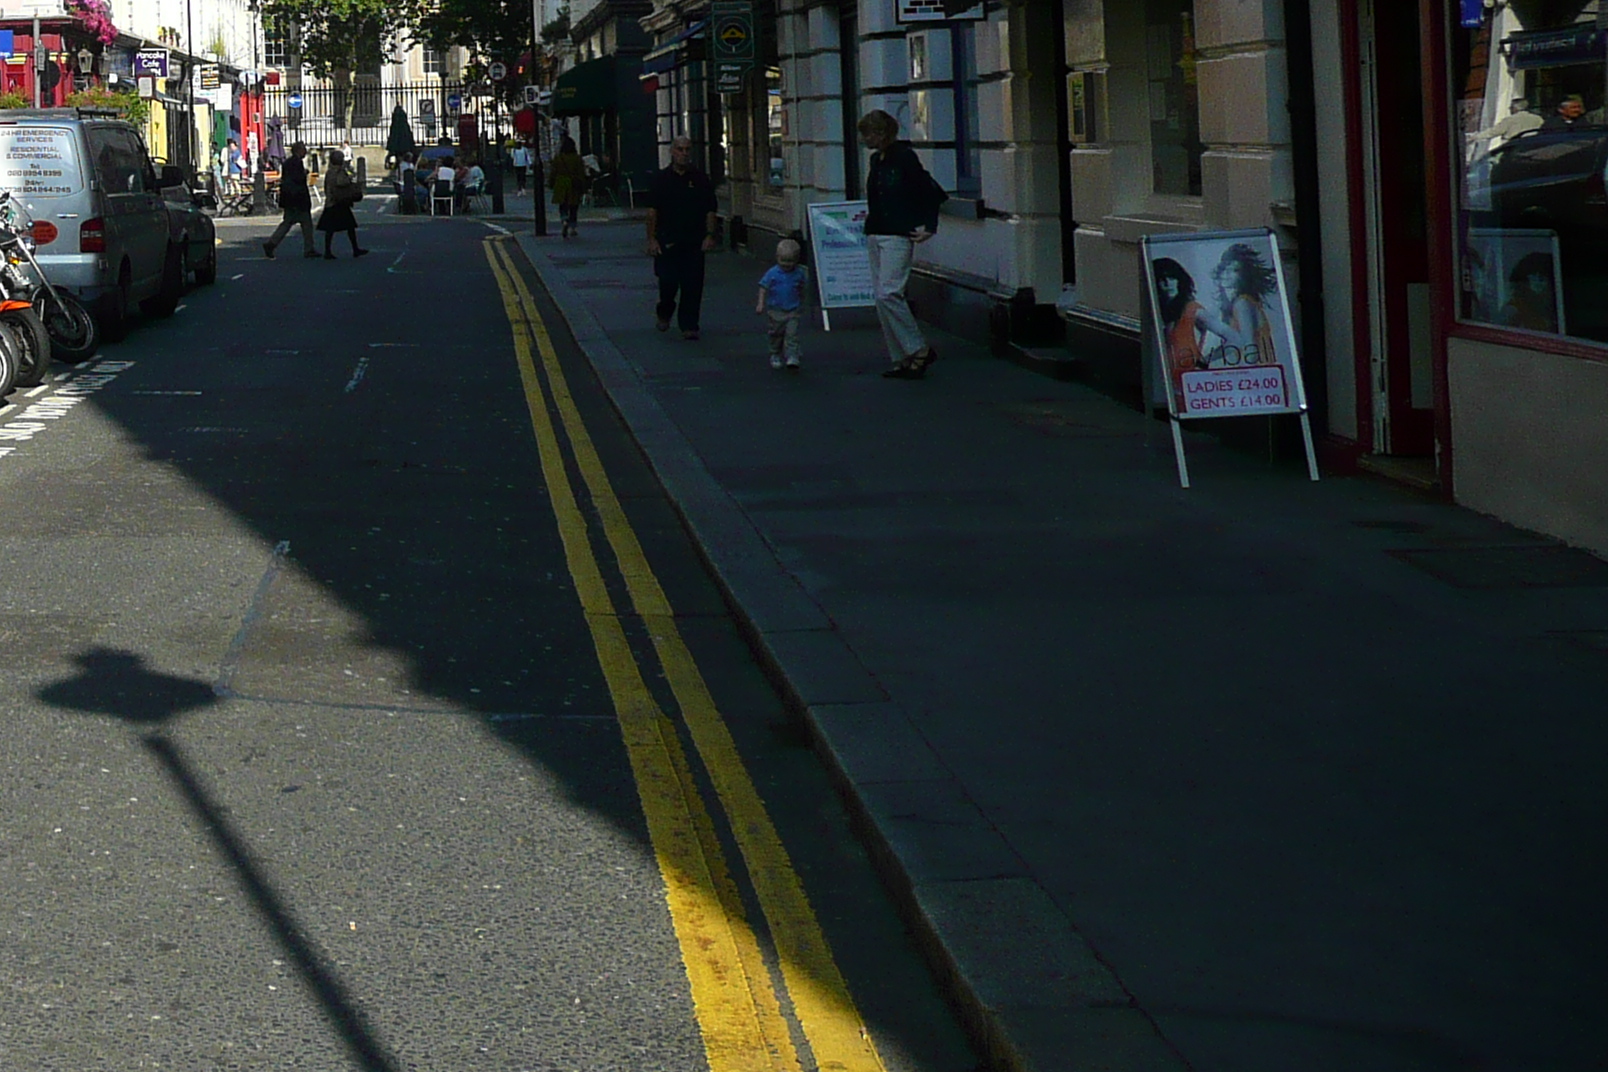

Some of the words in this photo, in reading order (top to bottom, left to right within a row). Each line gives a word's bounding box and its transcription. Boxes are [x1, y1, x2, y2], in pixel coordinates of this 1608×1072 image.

[136, 52, 166, 60] Pancake
[142, 59, 160, 68] Cafe
[1187, 380, 1234, 394] LADIES
[1238, 377, 1278, 391] £24.00
[1190, 397, 1235, 410] GENTS
[1240, 394, 1280, 408] £14.00
